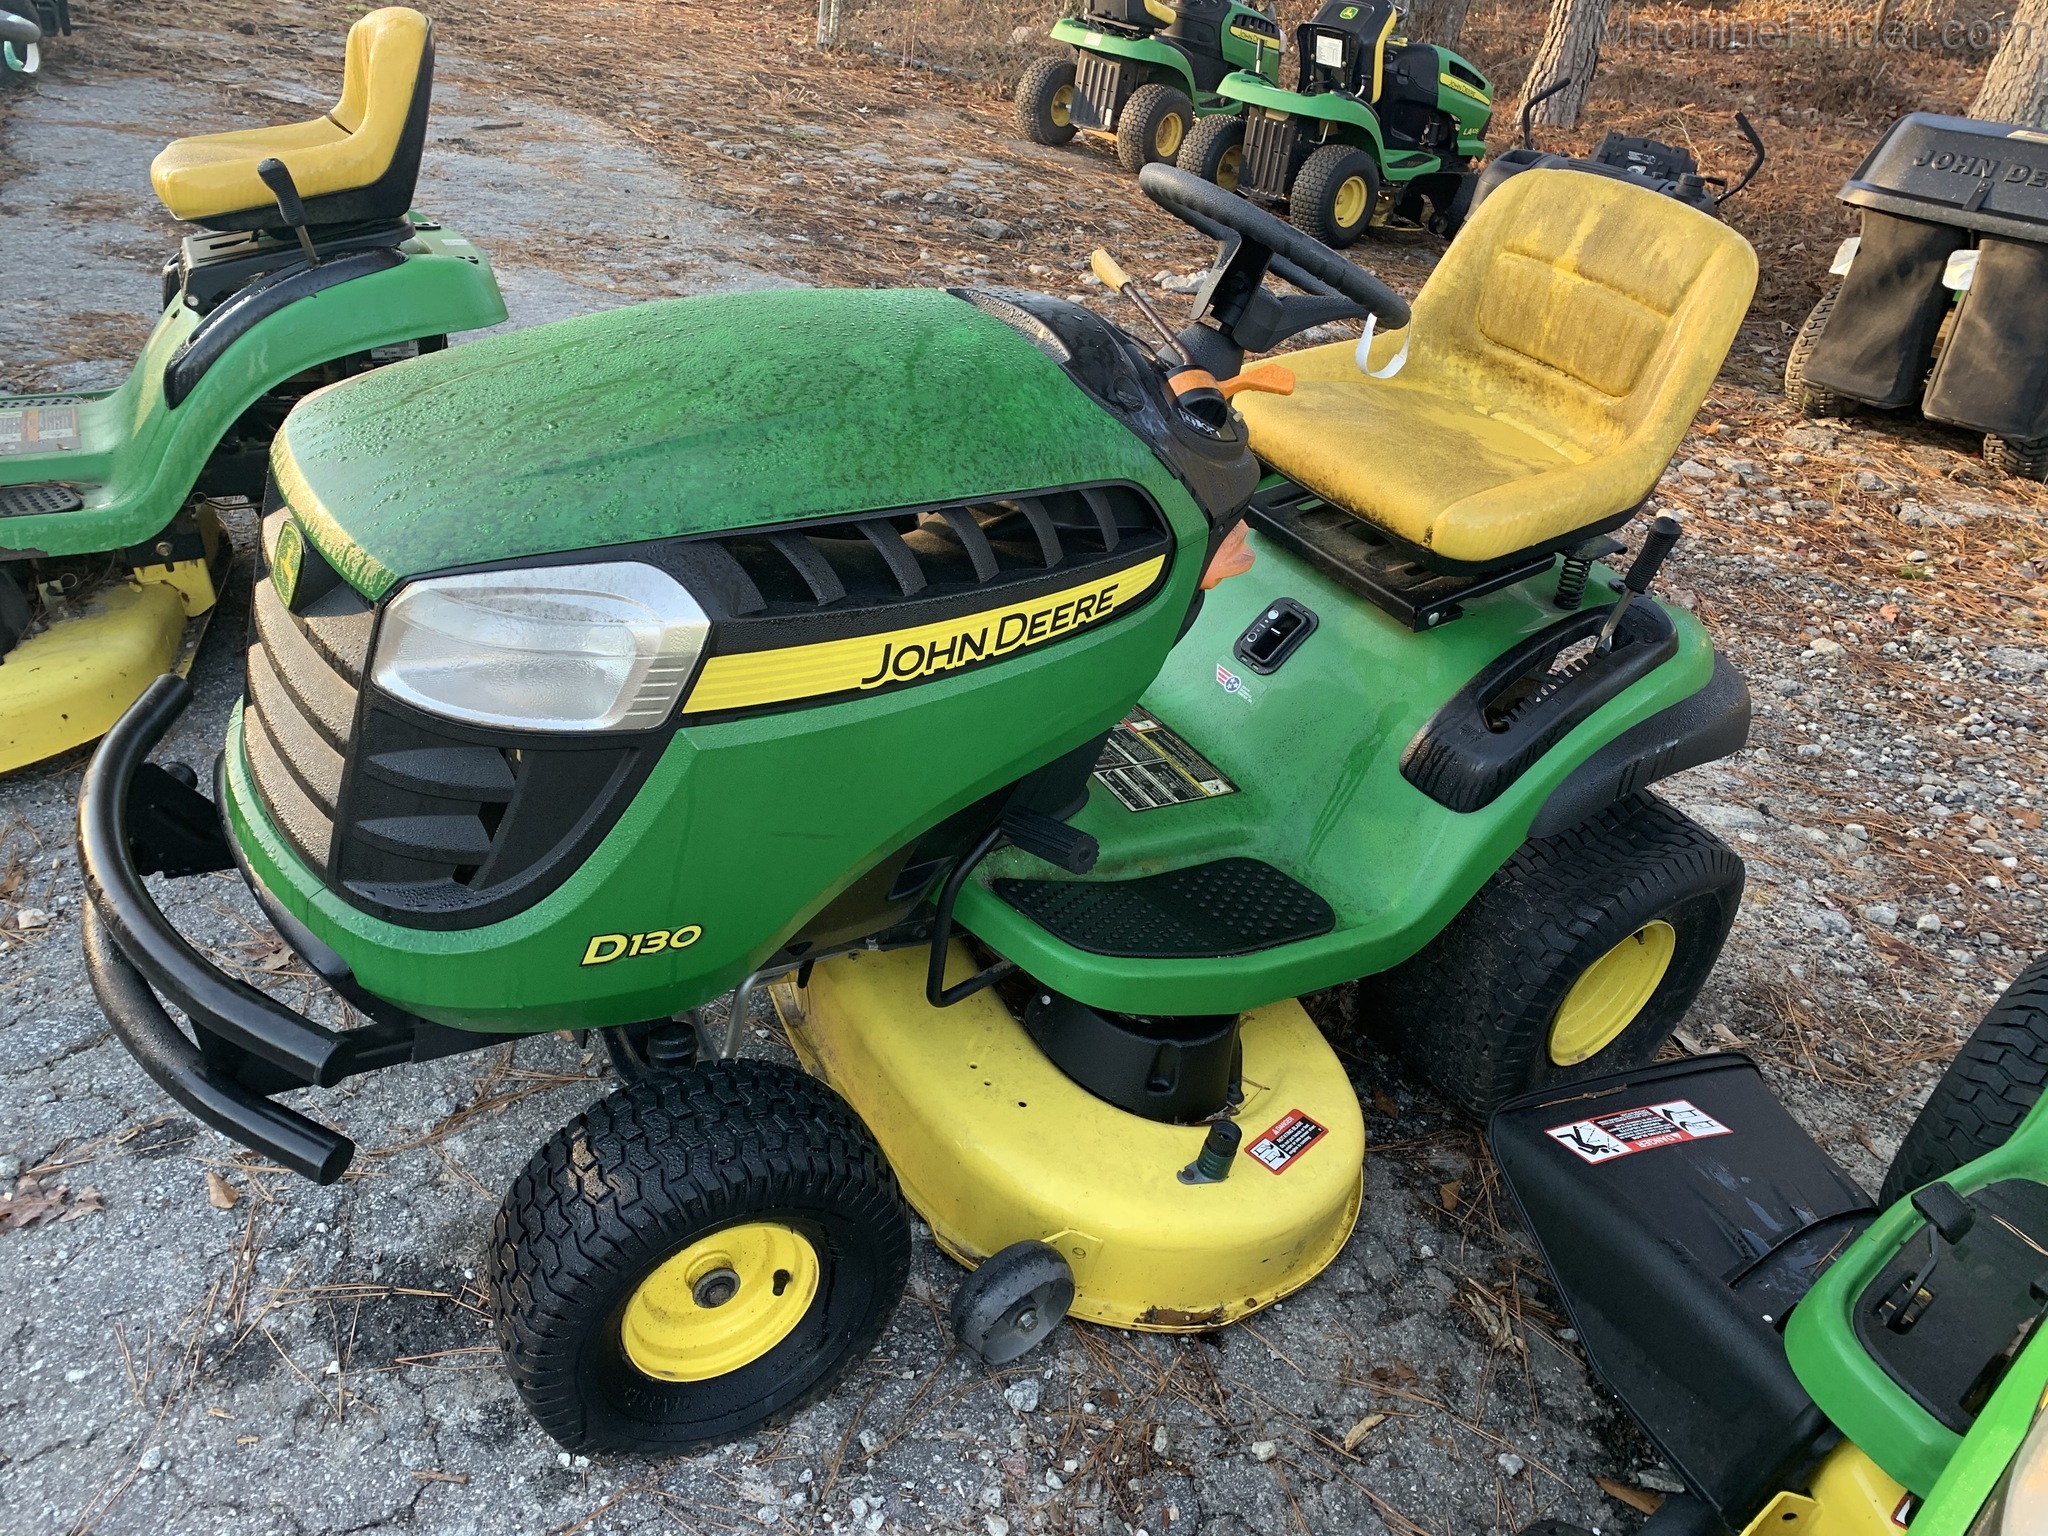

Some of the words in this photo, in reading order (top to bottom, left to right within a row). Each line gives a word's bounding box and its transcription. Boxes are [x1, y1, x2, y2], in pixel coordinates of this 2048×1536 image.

[1449, 80, 1463, 91] JOHN
[1462, 85, 1477, 98] DEERE
[1912, 149, 2000, 179] JOHN
[2003, 163, 2048, 190] DE
[860, 627, 989, 685] JOHN
[994, 583, 1119, 651] DEERE
[579, 923, 704, 967] D130
[1275, 1116, 1294, 1132] DANGER
[1635, 1136, 1675, 1148] DANGER
